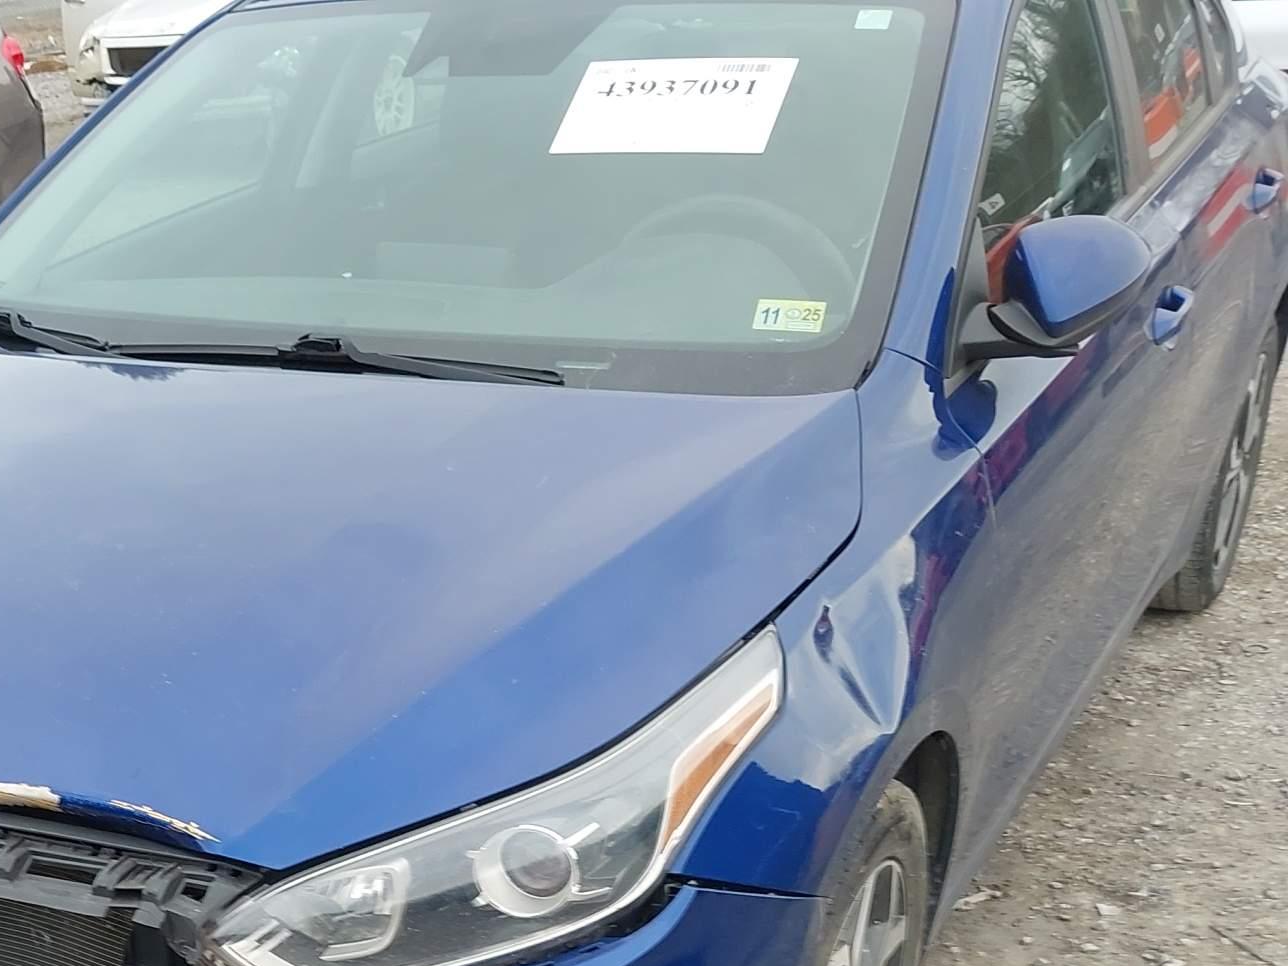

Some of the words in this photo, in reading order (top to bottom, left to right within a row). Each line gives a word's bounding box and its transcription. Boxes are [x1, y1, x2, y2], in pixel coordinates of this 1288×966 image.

[597, 79, 757, 97] 43937091
[761, 307, 780, 325] 11
[801, 308, 822, 322] 25
